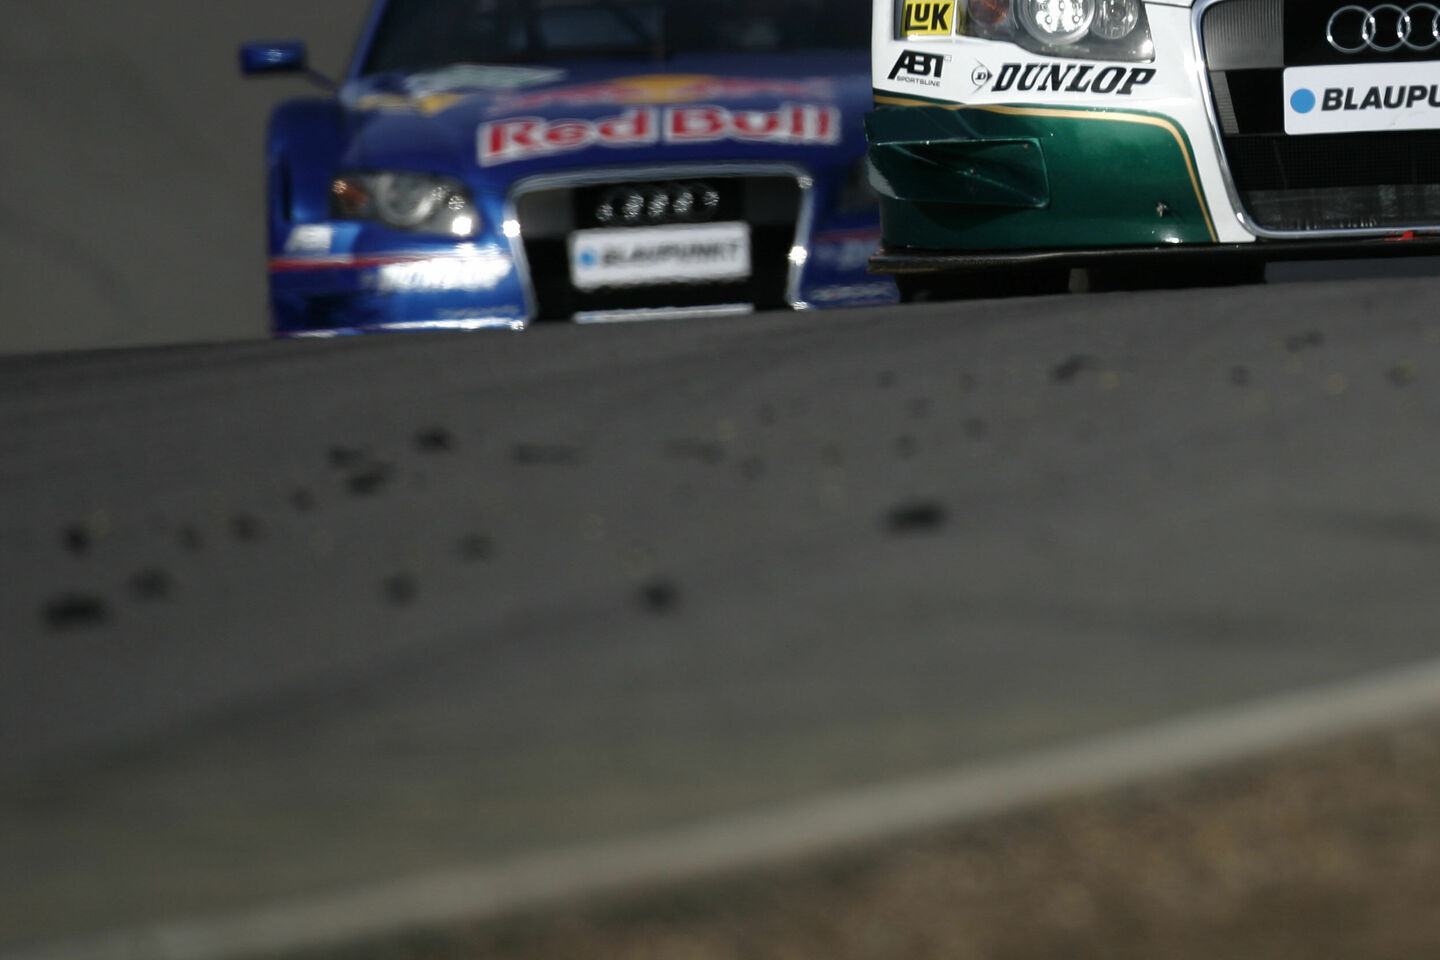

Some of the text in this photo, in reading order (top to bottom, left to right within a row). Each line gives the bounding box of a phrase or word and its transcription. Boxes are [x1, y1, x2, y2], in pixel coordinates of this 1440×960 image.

[888, 50, 944, 80] ABT
[991, 63, 1157, 95] DUNLOP
[897, 76, 941, 87] SPORTSLINE
[477, 102, 841, 167] Red Bull
